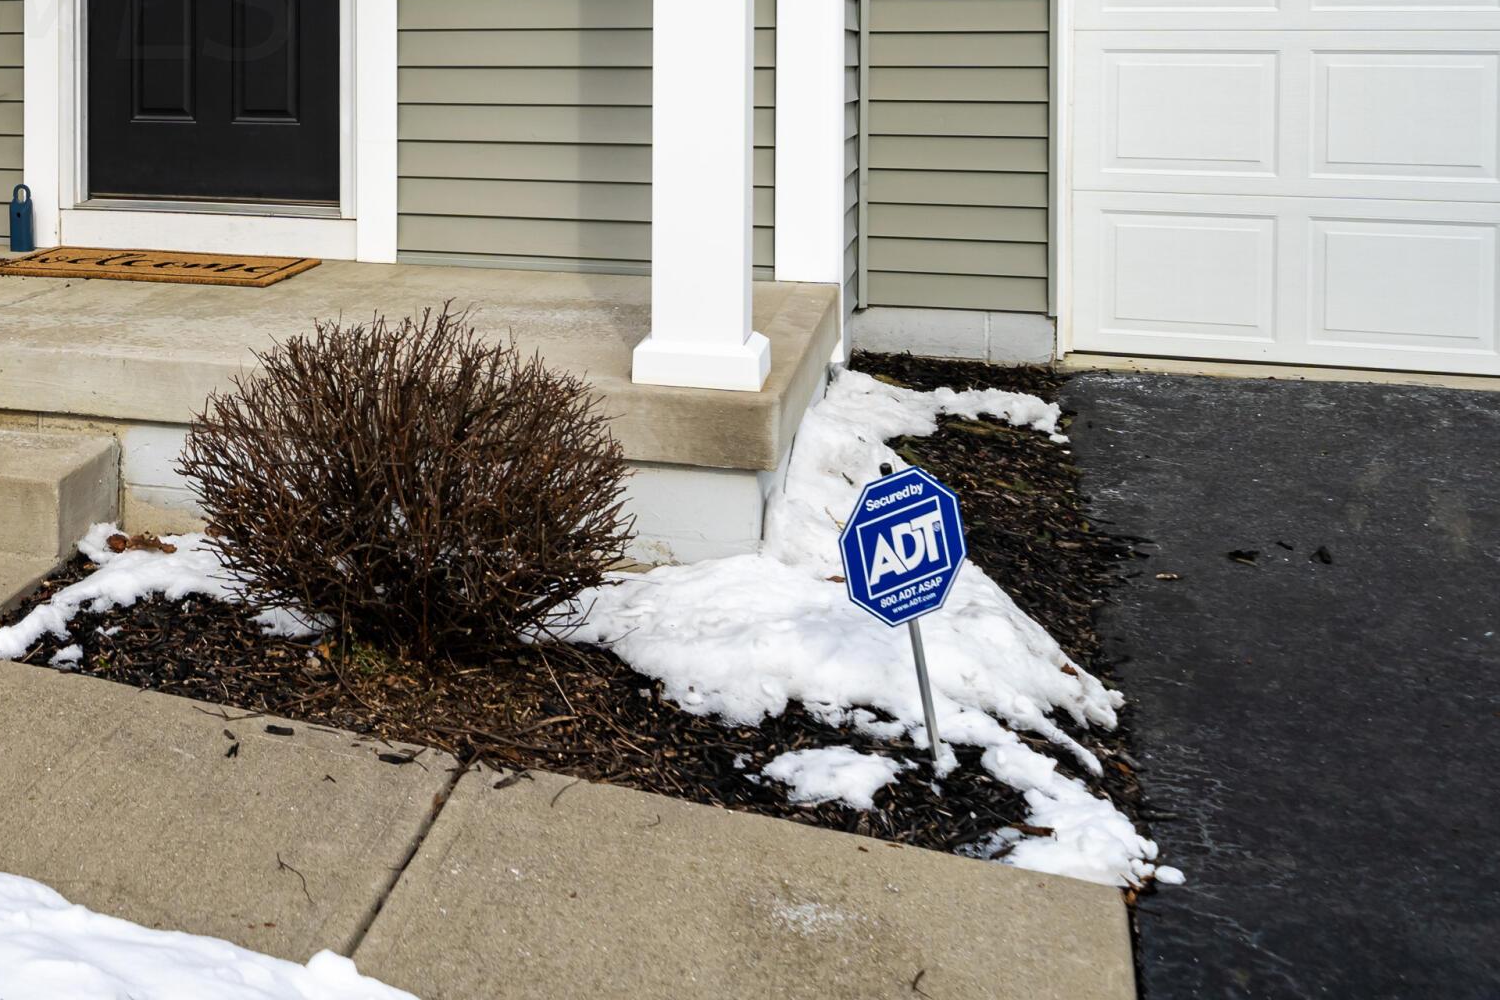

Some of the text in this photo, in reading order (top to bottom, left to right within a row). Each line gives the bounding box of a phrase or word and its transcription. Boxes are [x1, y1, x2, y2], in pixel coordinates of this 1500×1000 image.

[23, 252, 280, 273] welcome
[865, 483, 924, 512] Secured by
